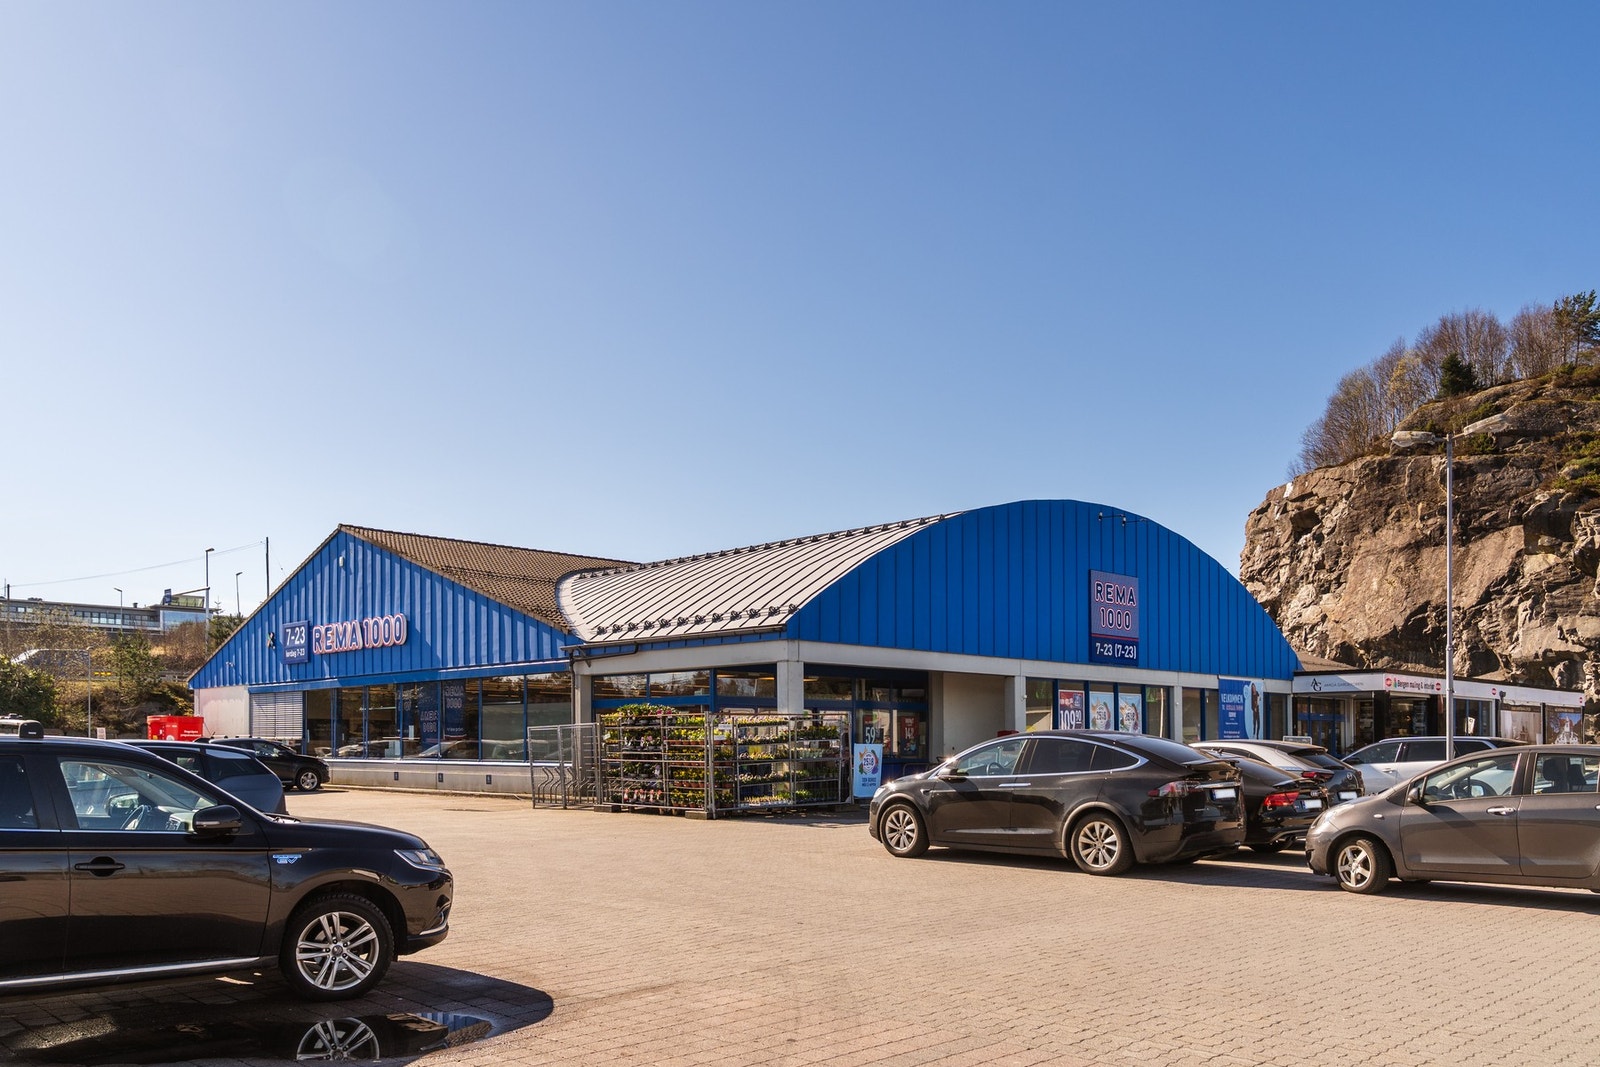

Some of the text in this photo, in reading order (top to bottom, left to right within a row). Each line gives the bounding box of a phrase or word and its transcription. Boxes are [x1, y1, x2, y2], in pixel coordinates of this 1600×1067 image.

[1094, 581, 1137, 607] REMA
[1099, 607, 1132, 631] 1000
[286, 626, 306, 646] 7-23
[312, 613, 407, 654] REMA 1000
[1095, 642, 1137, 659] 7-23 (7-23)
[1060, 709, 1076, 730] 109
[865, 726, 876, 744] 59
